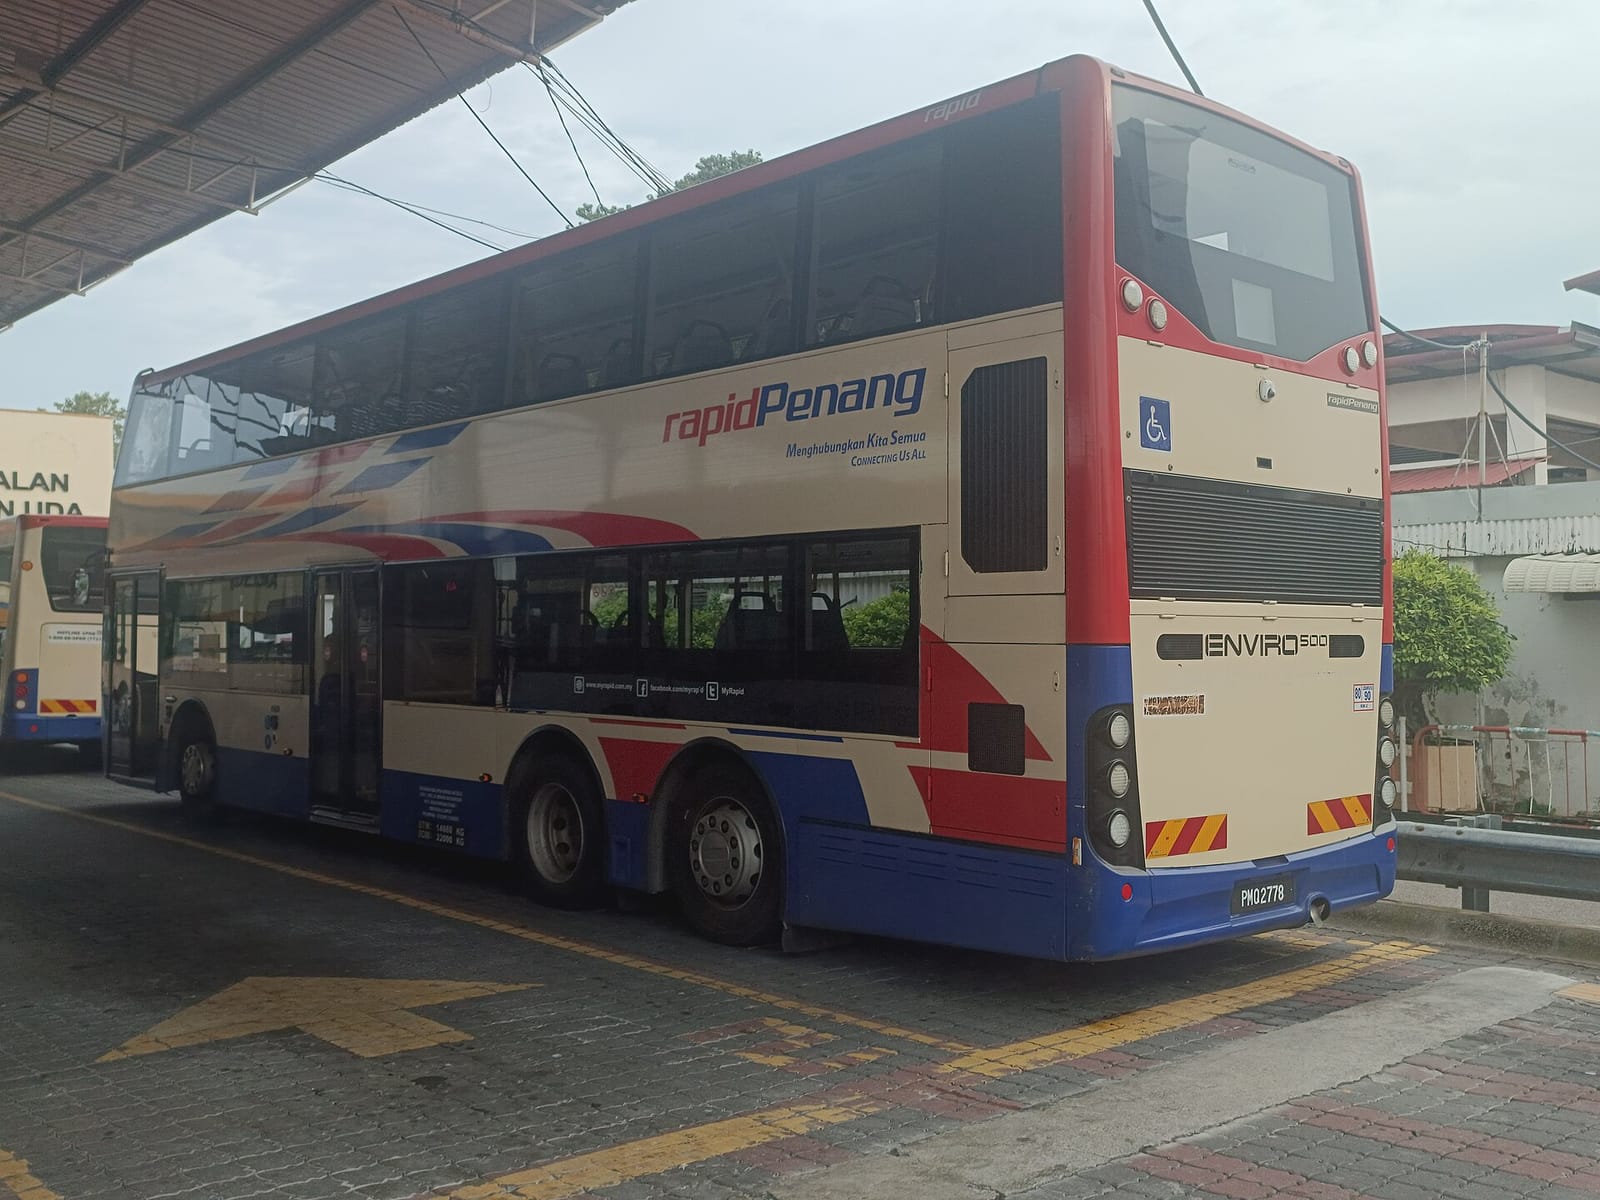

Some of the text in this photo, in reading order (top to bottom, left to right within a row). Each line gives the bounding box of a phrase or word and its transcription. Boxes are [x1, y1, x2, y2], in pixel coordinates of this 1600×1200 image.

[924, 92, 981, 123] rapid
[662, 367, 927, 447] rapidPenang
[1328, 395, 1378, 413] rapidPenang
[785, 430, 927, 459] Menghubungkan Kita Semua
[721, 687, 745, 697] MyRapid
[1355, 687, 1361, 699] 80
[1364, 690, 1371, 701] 90
